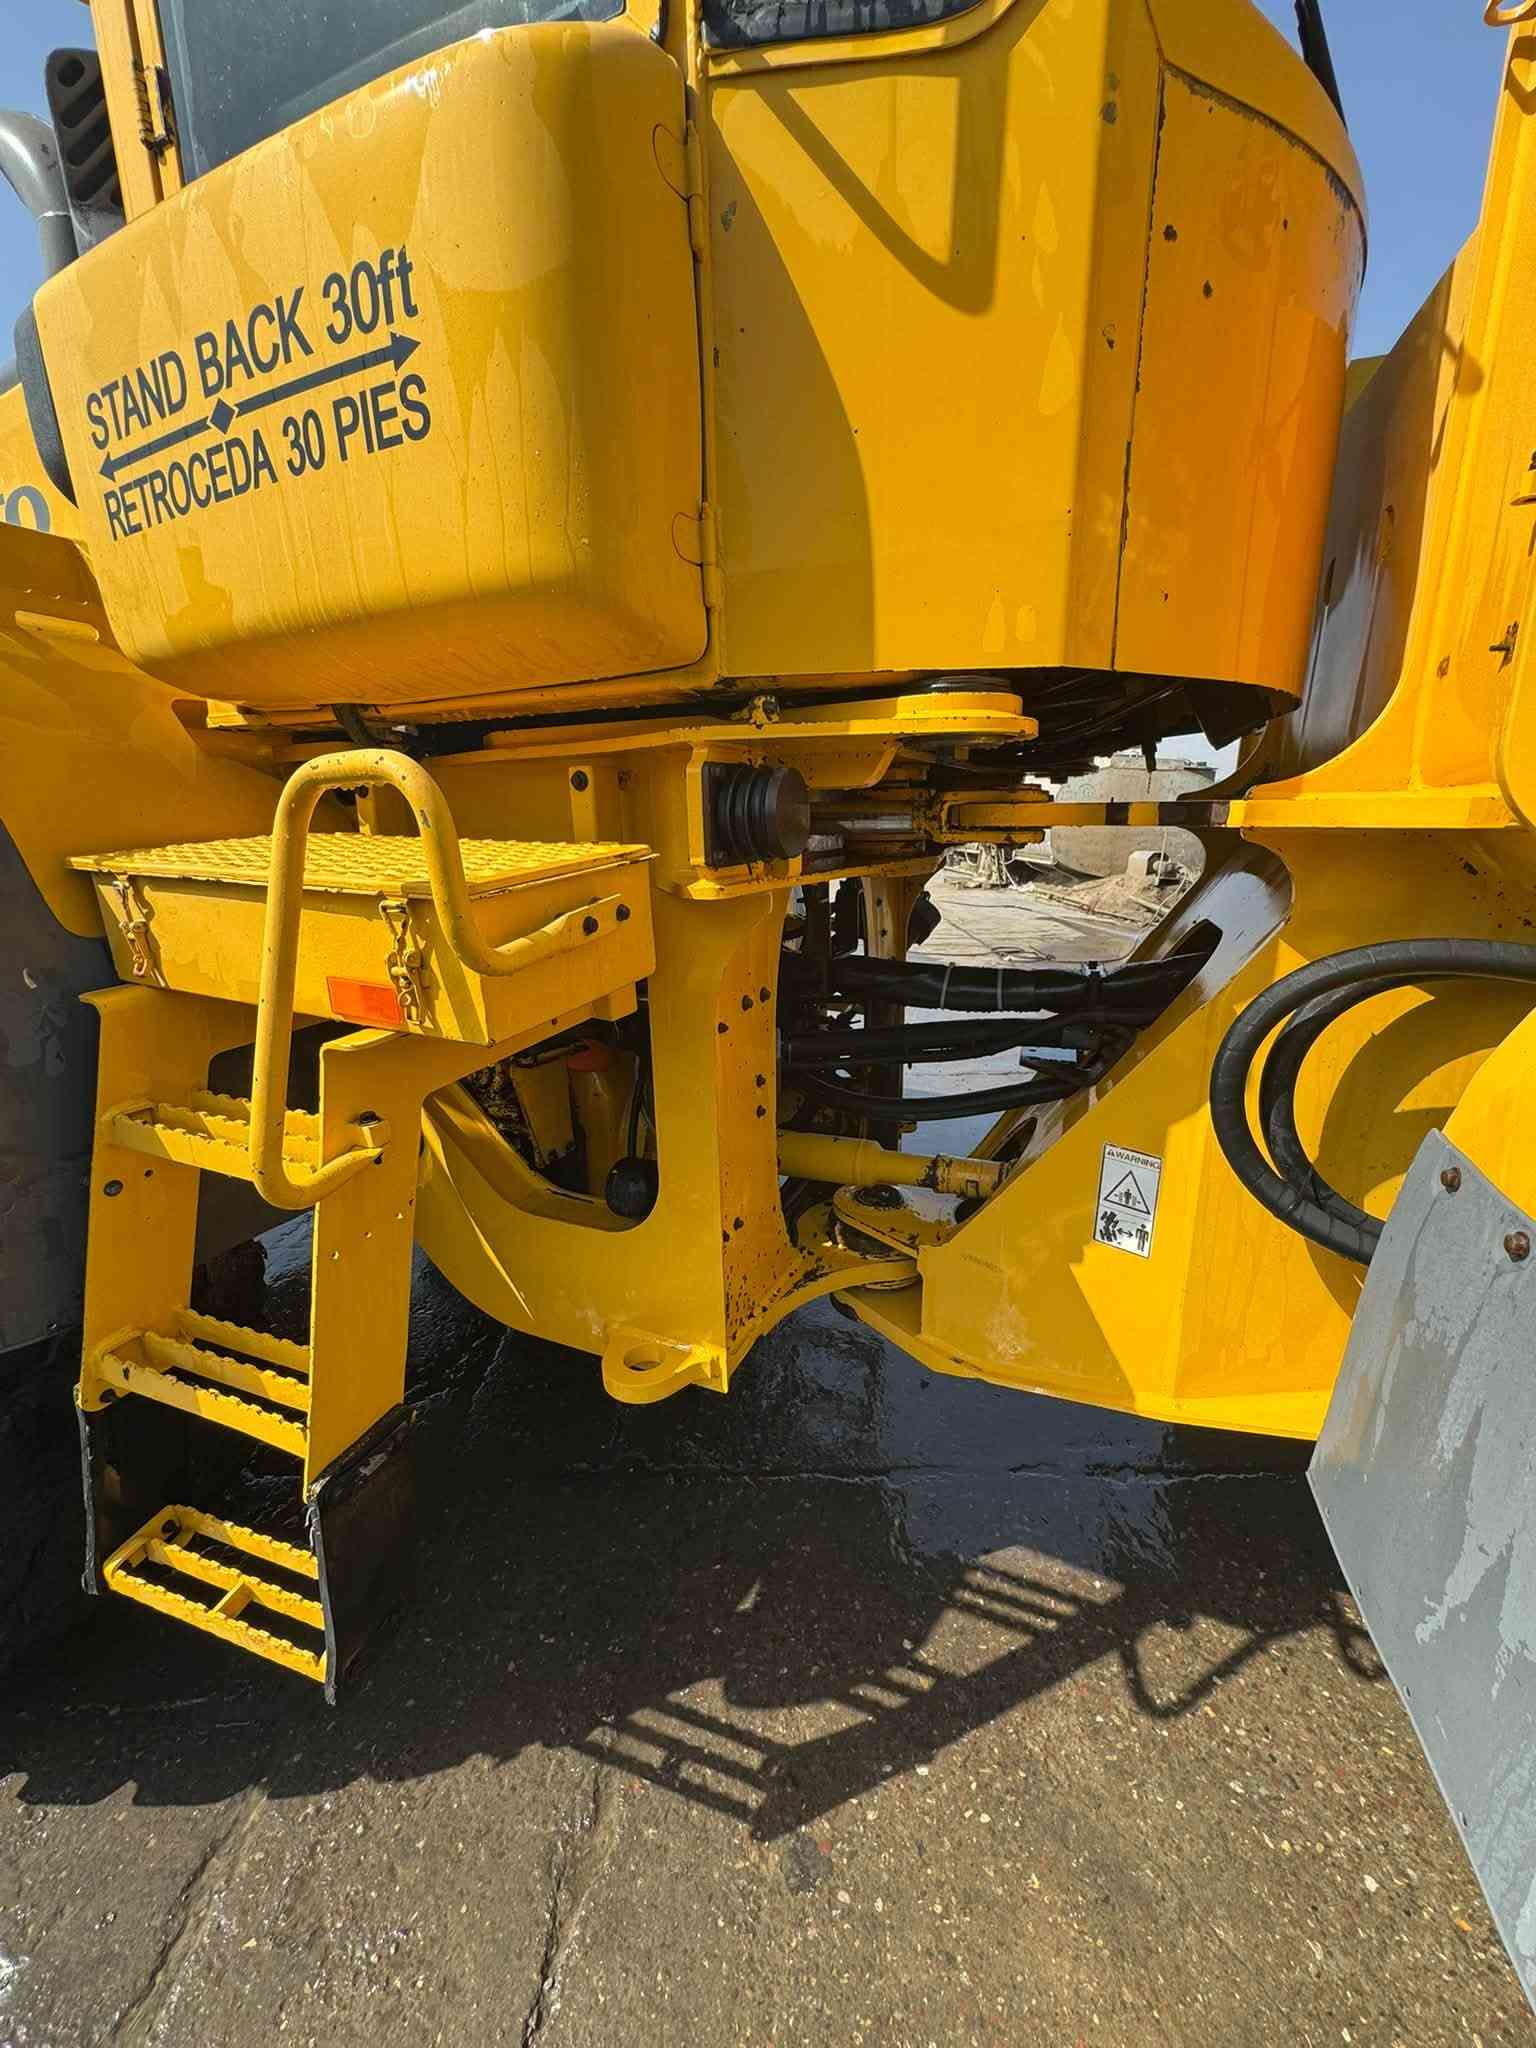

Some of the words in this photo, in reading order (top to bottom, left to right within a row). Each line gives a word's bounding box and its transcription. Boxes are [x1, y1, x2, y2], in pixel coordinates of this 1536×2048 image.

[86, 350, 188, 450] STAND
[194, 286, 314, 399] BACK
[322, 244, 419, 345] 30ft
[104, 429, 279, 541] RETROCEDA
[282, 408, 326, 477] 30
[333, 373, 432, 462] PIES
[1115, 1151, 1160, 1169] WARNING
